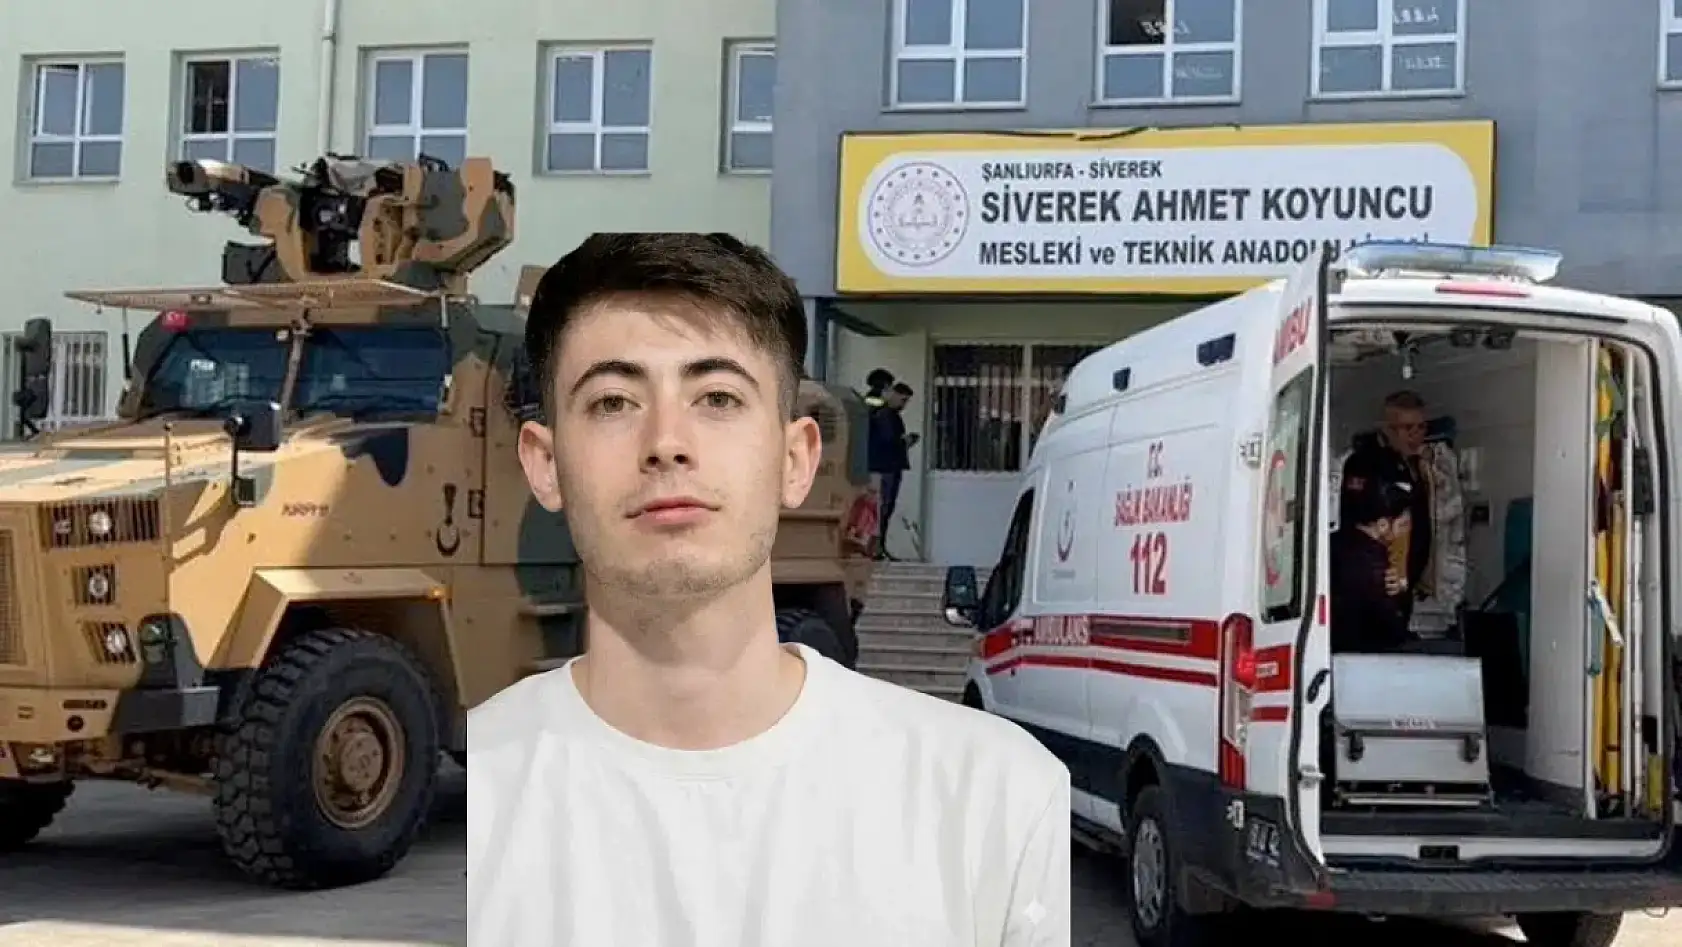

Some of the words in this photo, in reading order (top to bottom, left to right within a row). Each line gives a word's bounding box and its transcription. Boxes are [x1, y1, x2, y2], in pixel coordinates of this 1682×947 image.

[981, 161, 1074, 182] ŞANLIURFA
[1088, 158, 1163, 179] SİVEREK
[980, 184, 1122, 223] SİVEREK
[1131, 188, 1251, 222] AHMET
[1262, 184, 1433, 220] KOYUNCU
[978, 235, 1082, 266] MESLEKİ
[1089, 245, 1117, 265] ve
[1123, 234, 1215, 265] TEKNİK
[1130, 531, 1167, 594] 112
